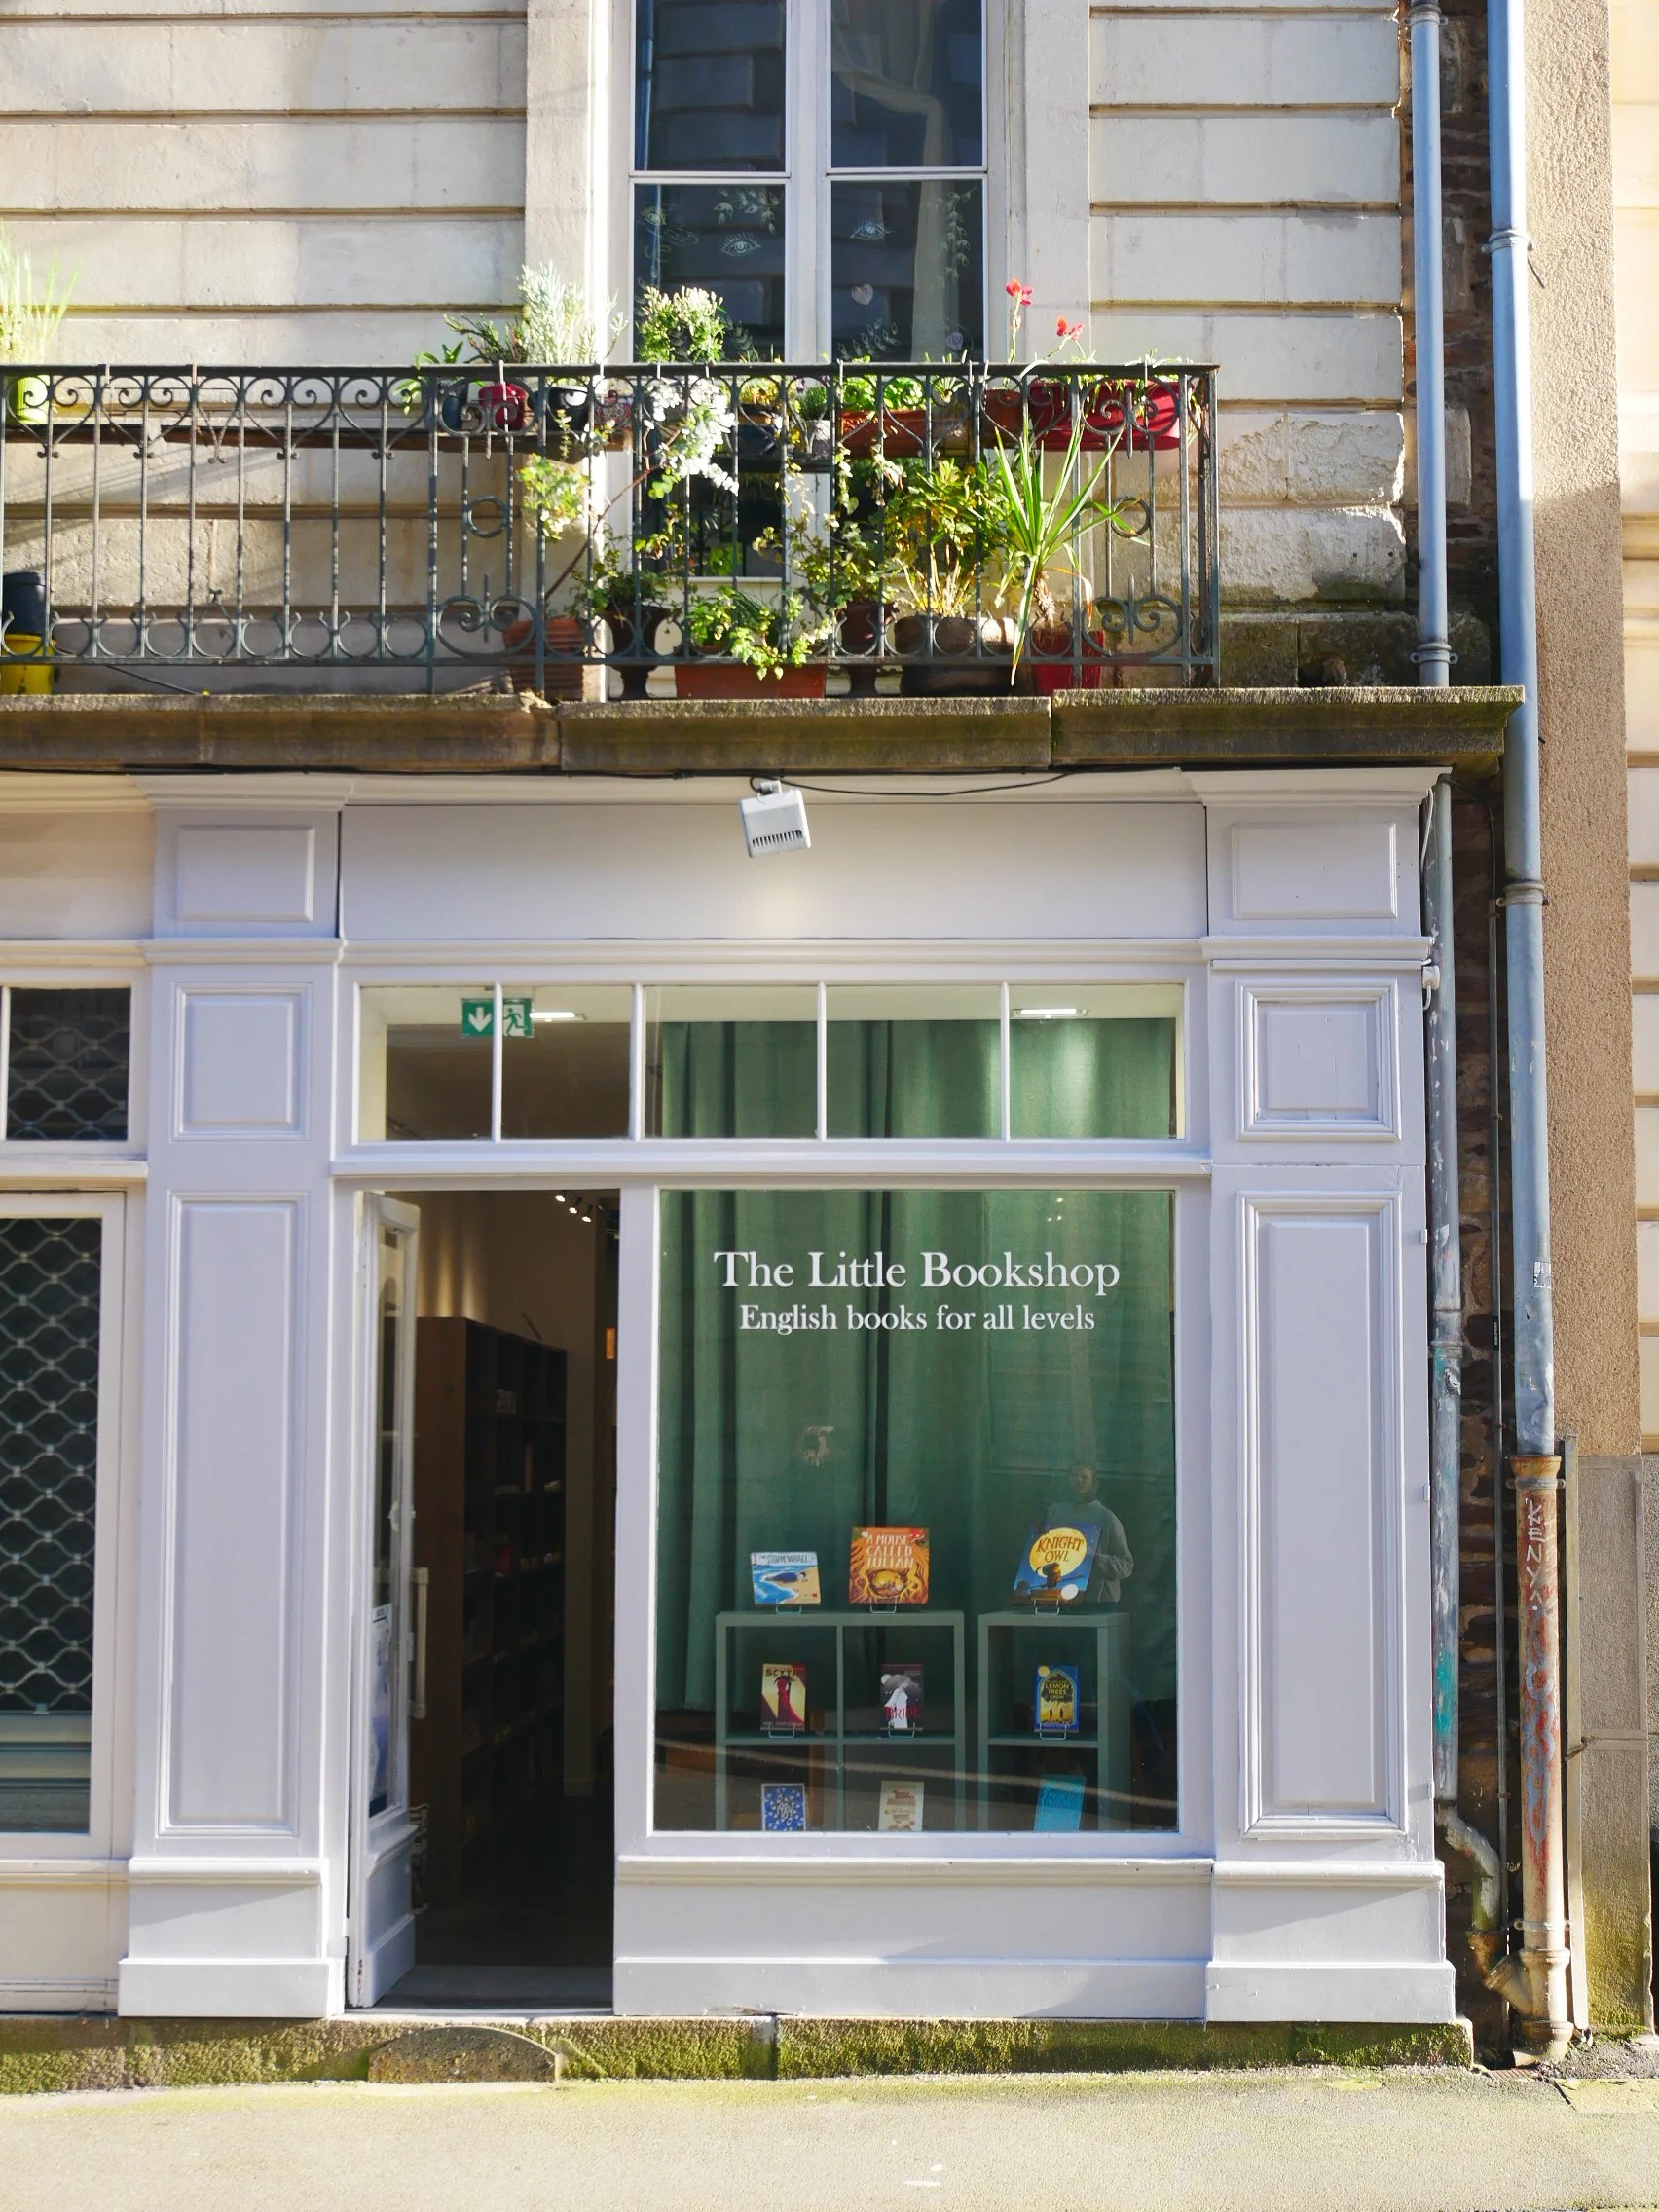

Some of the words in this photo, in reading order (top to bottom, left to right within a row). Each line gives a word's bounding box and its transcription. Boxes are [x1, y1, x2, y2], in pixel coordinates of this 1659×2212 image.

[714, 1251, 794, 1287] The
[807, 1251, 907, 1287] Little
[920, 1251, 1120, 1296] Bookshop
[739, 1304, 838, 1336] English
[846, 1304, 928, 1330] books
[936, 1304, 976, 1330] for
[983, 1304, 1014, 1330] all
[1022, 1304, 1095, 1330] levels
[866, 1534, 874, 1544] A
[875, 1533, 907, 1545] MOUSE
[1036, 1536, 1084, 1553] KNIGHT
[866, 1545, 913, 1557] CALLED
[1045, 1550, 1070, 1563] OWL
[866, 1557, 914, 1568] JULIAN
